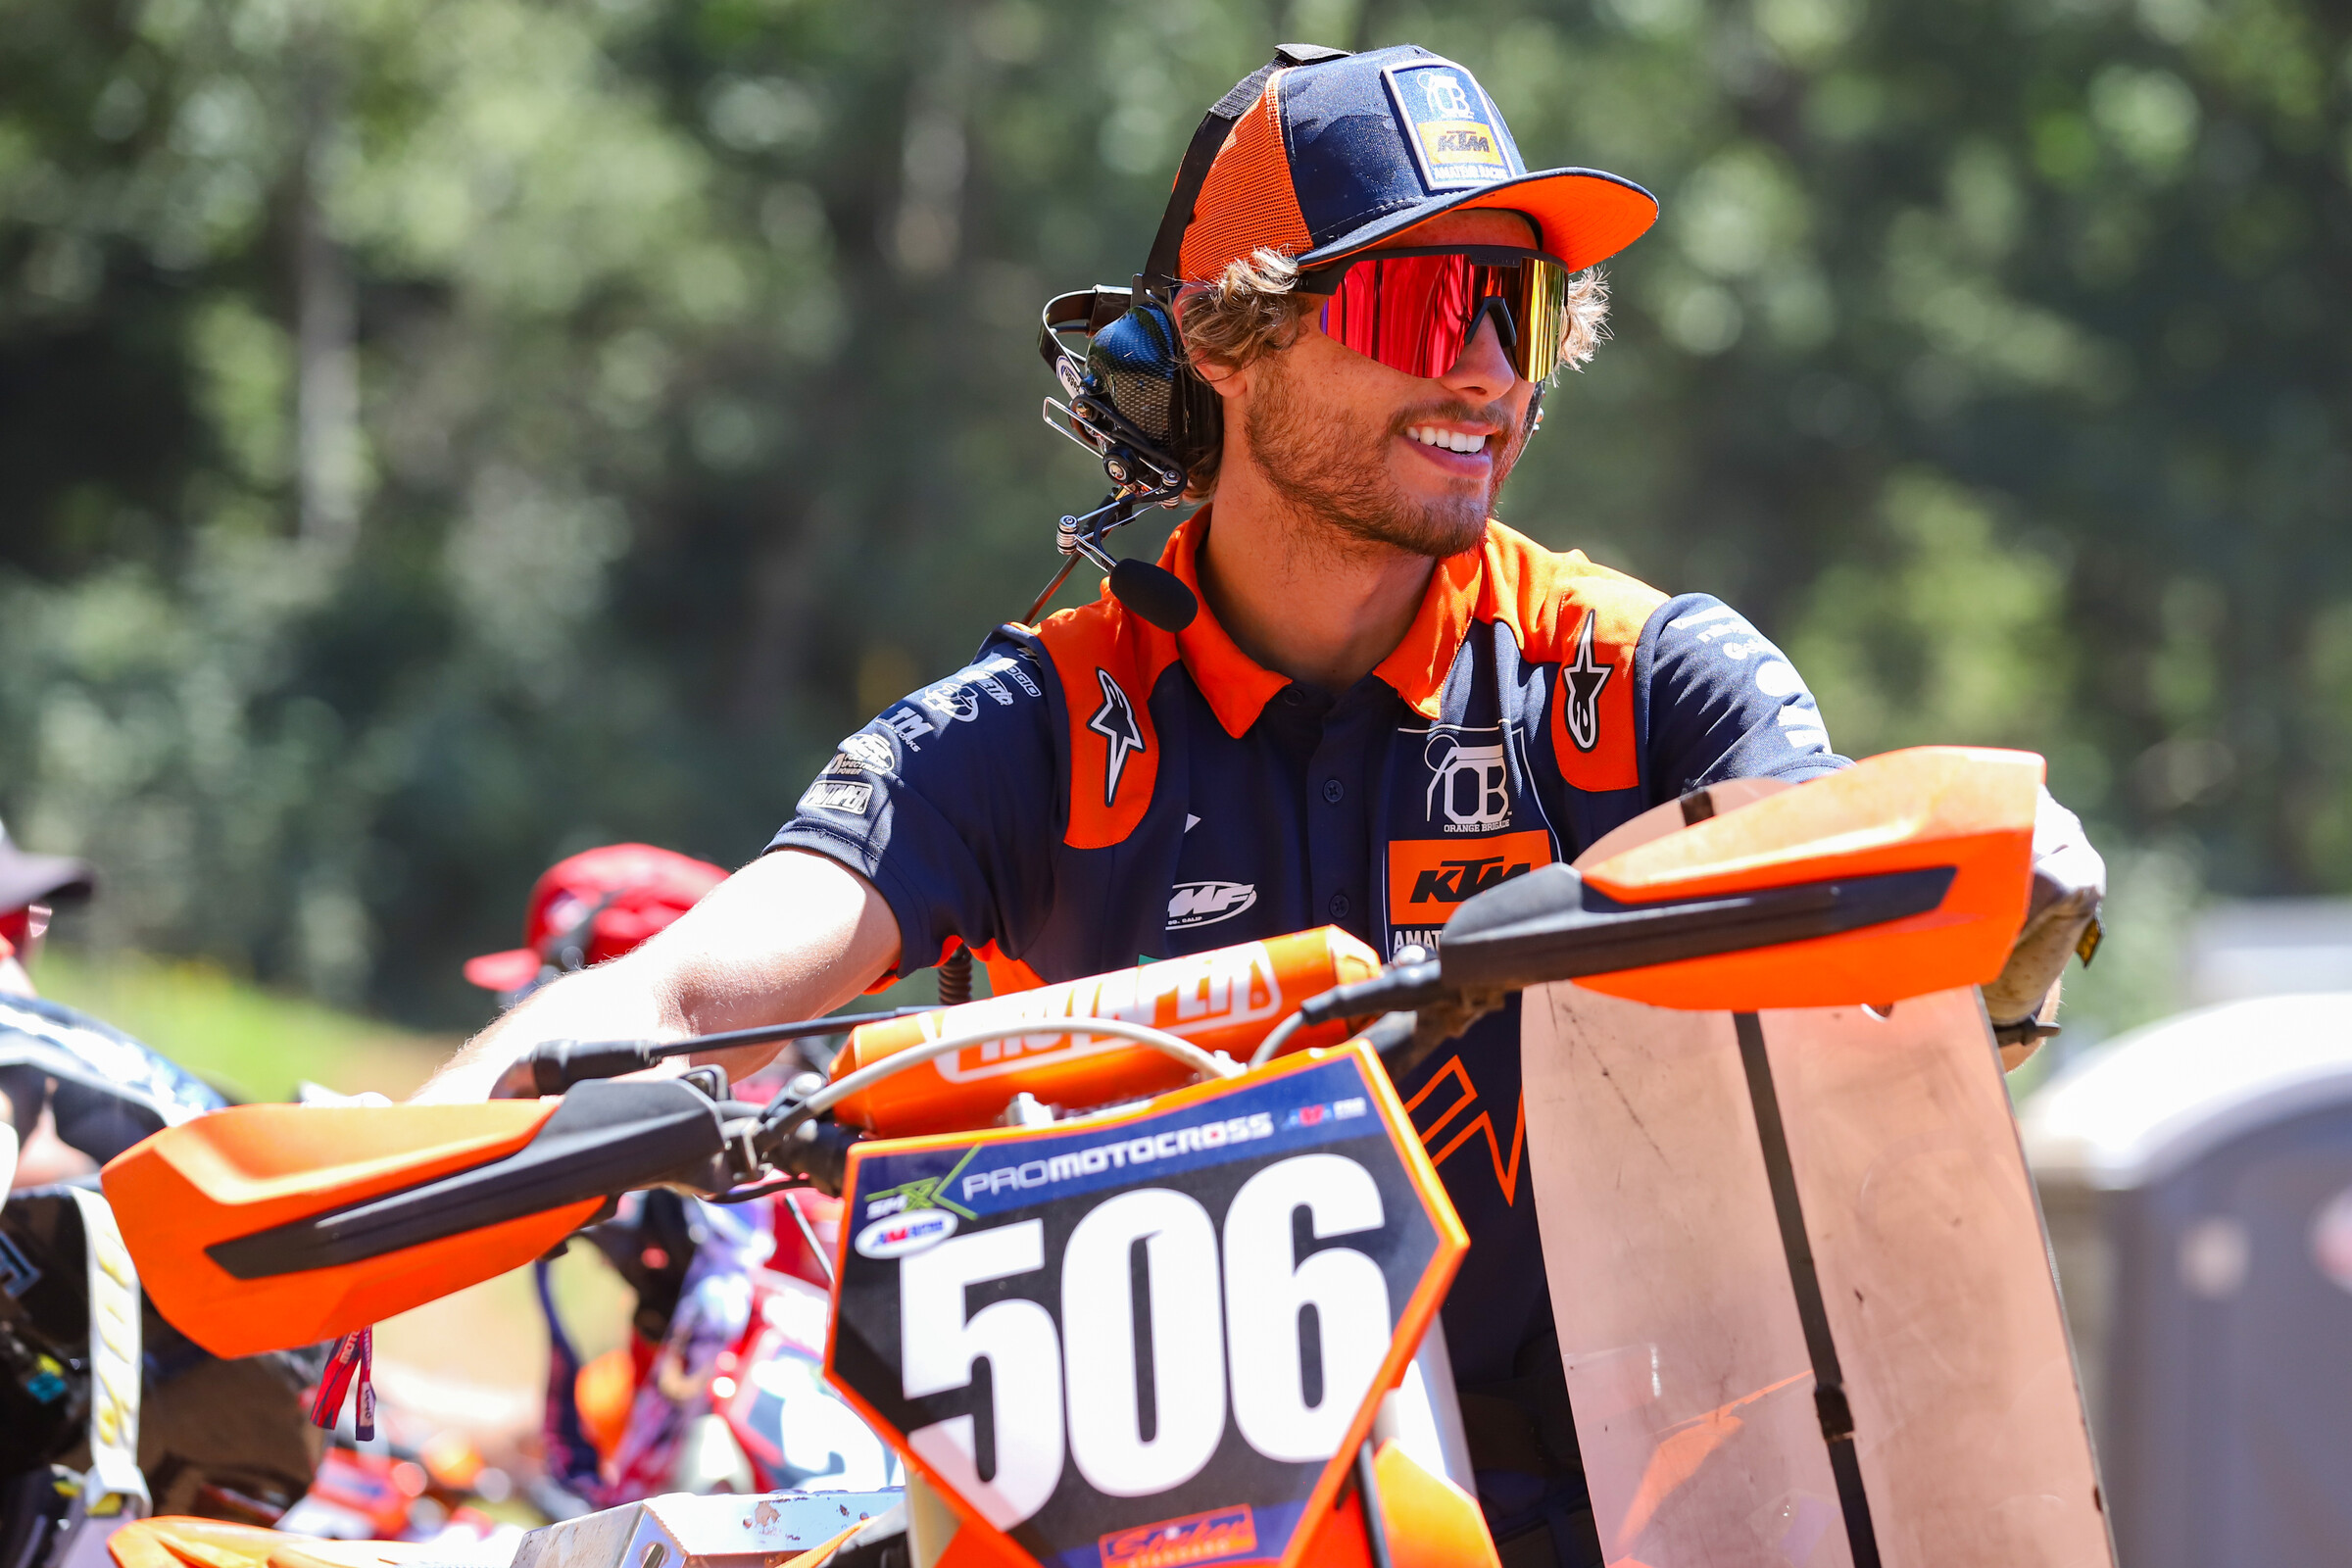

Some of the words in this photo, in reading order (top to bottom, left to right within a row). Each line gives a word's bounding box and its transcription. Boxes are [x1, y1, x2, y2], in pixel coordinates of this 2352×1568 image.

[1437, 129, 1491, 153] KTM
[1435, 166, 1479, 181] AMATEUR
[884, 706, 935, 740] TM
[1444, 824, 1481, 833] ORANGE
[1481, 819, 1510, 832] BRIGADE
[1409, 856, 1531, 904] KTM
[1393, 930, 1443, 955] AMAT
[900, 1152, 1393, 1534] 506
